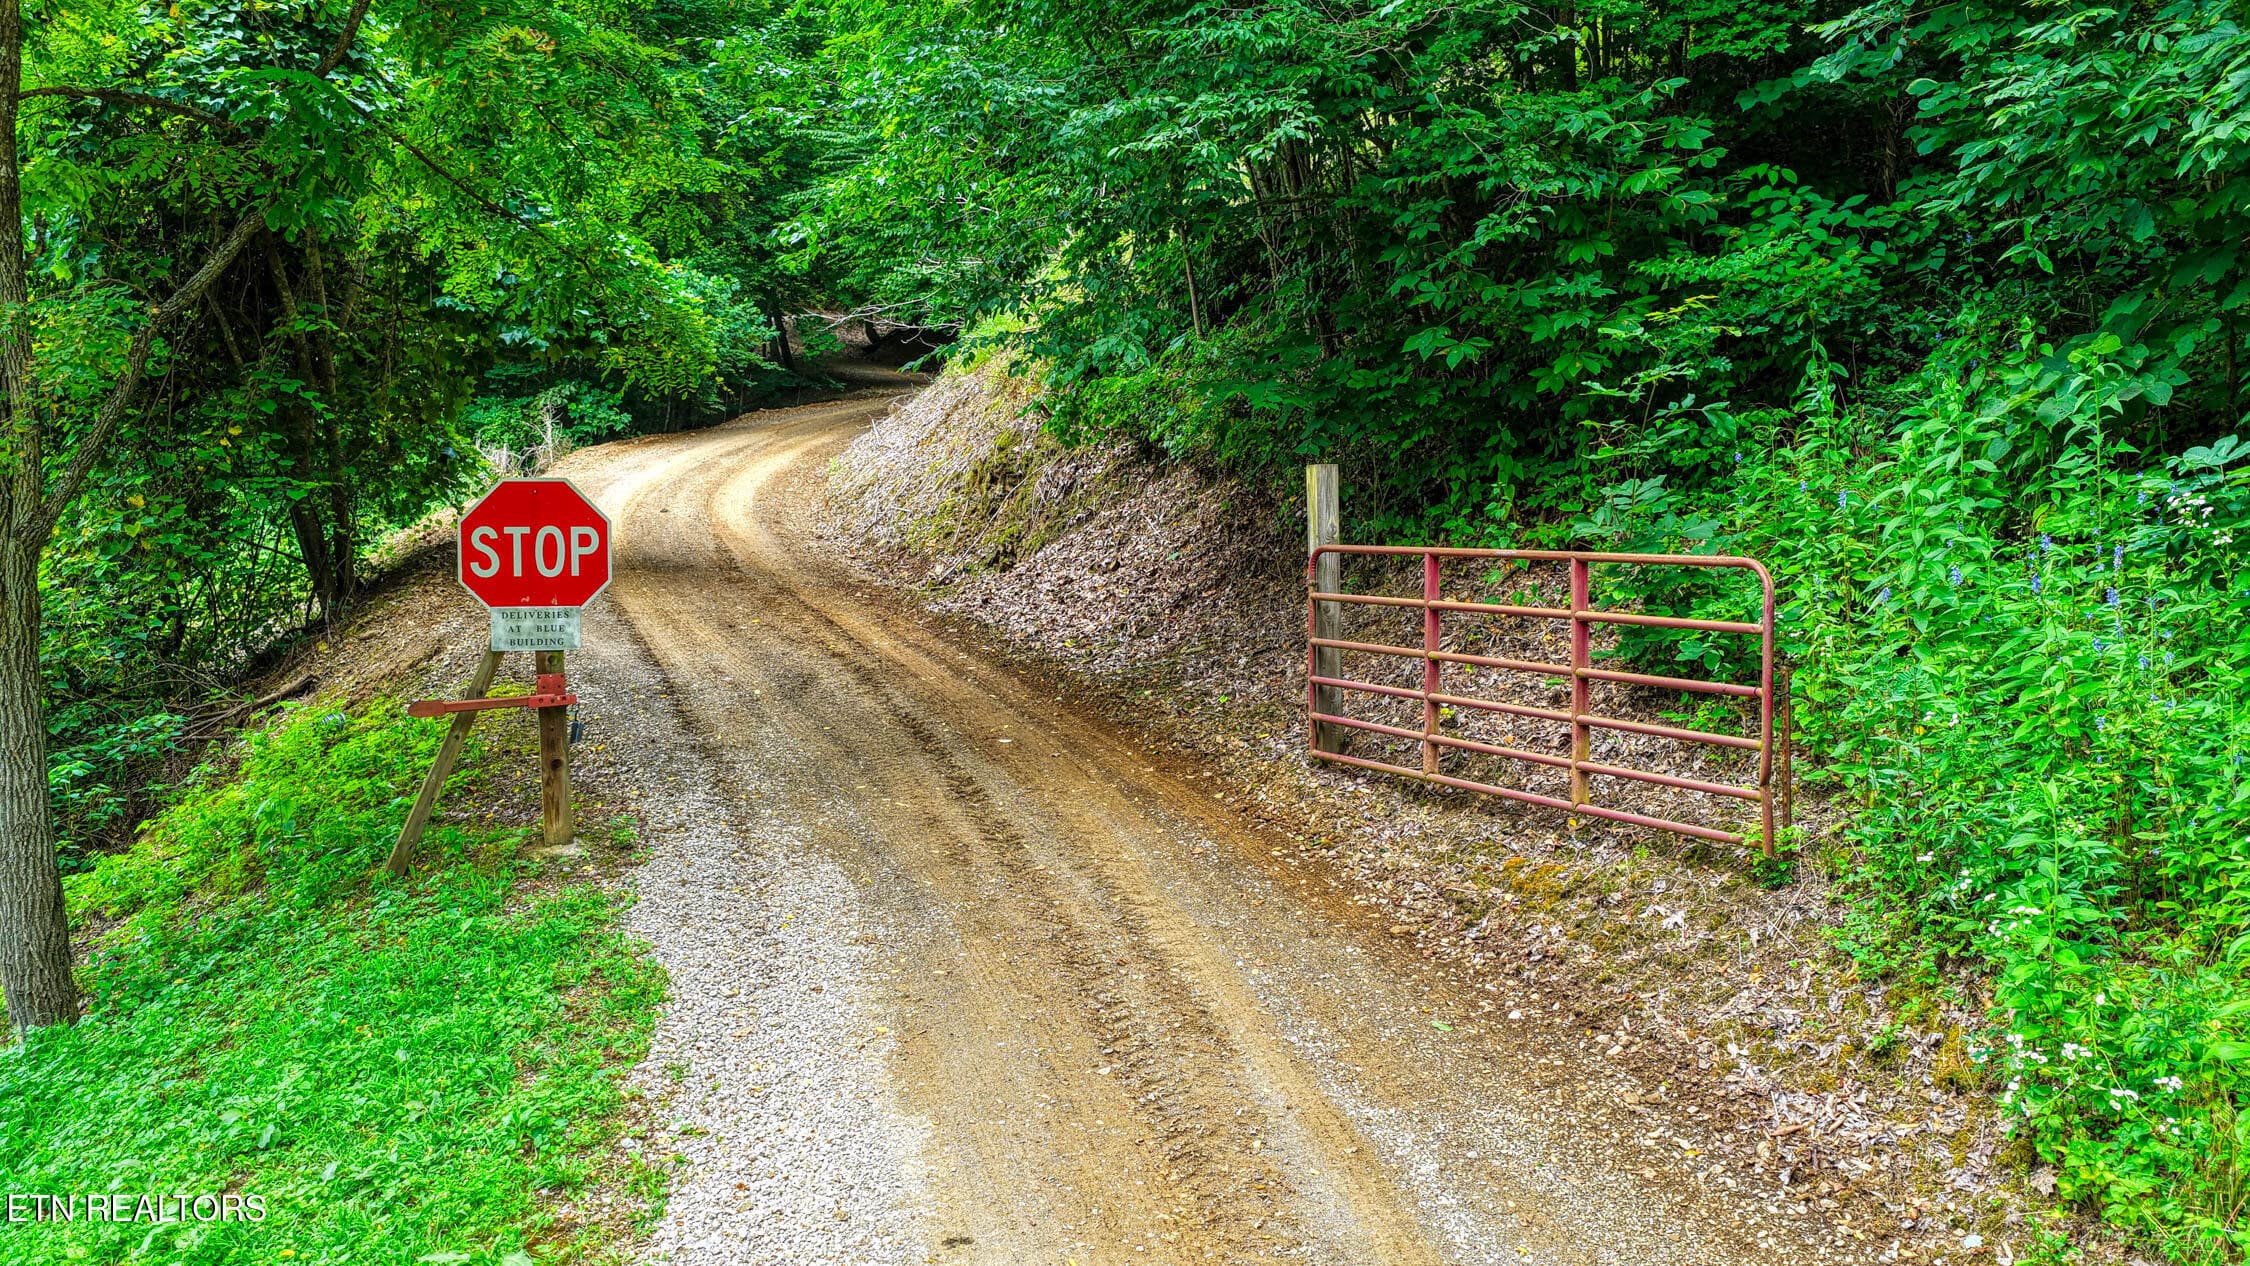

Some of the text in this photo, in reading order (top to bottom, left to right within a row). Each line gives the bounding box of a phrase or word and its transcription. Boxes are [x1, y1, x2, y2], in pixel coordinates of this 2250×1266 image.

[470, 525, 599, 578] STOP
[501, 610, 570, 619] DELIVERIES
[507, 624, 566, 633] AT BLUE
[509, 637, 564, 646] BUILDING
